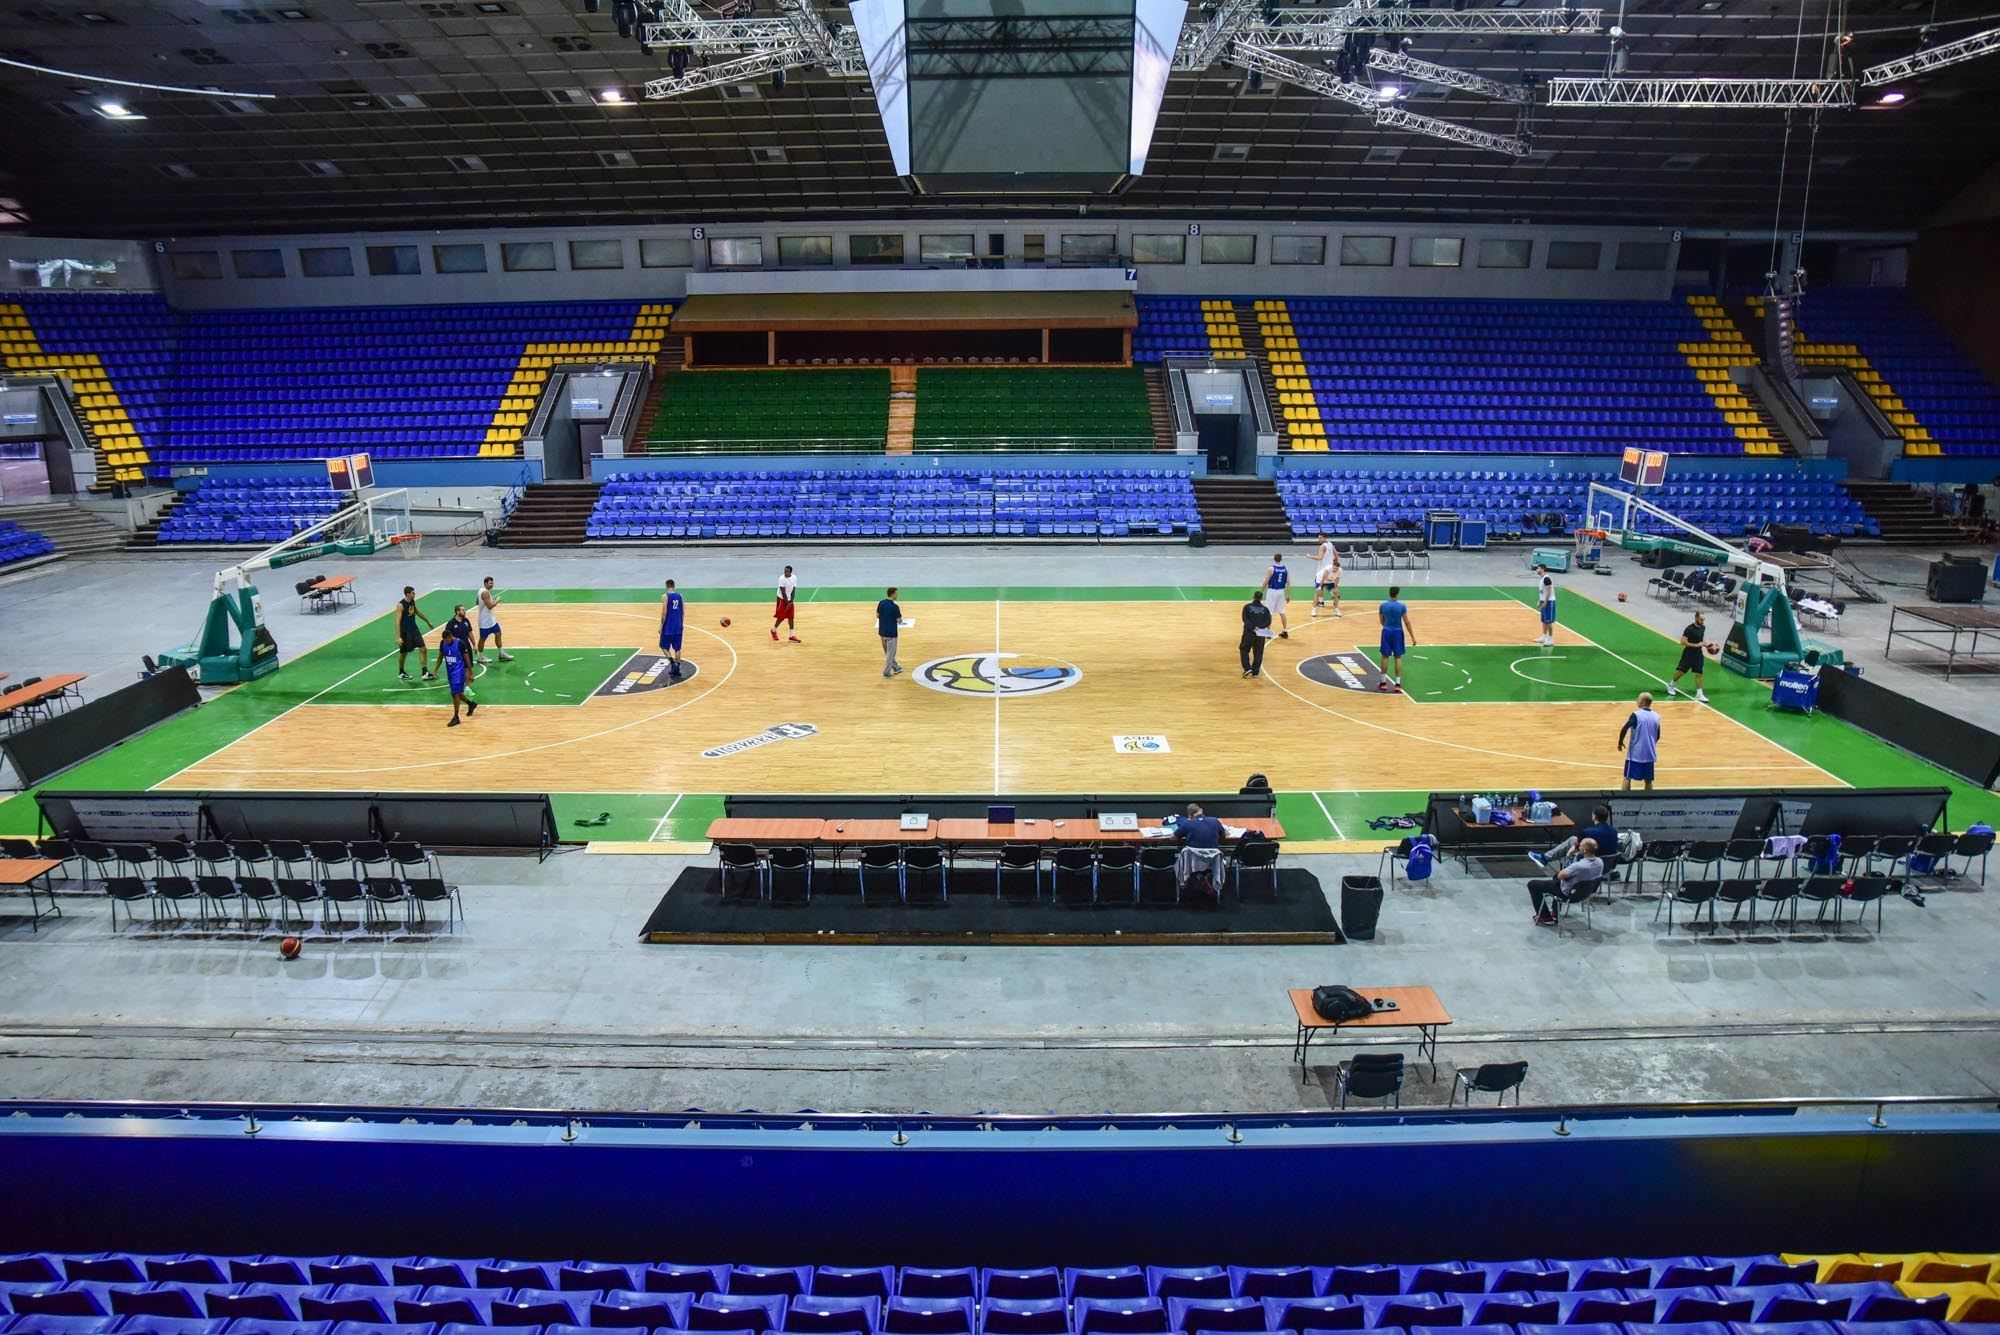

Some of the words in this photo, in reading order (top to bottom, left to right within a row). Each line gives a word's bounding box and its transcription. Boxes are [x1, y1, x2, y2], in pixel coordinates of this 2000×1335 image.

[694, 228, 702, 239] 6
[1190, 224, 1199, 235] 8
[1673, 231, 1681, 241] 8
[155, 241, 164, 252] 6
[1127, 269, 1136, 280] 7
[1779, 680, 1808, 691] molten
